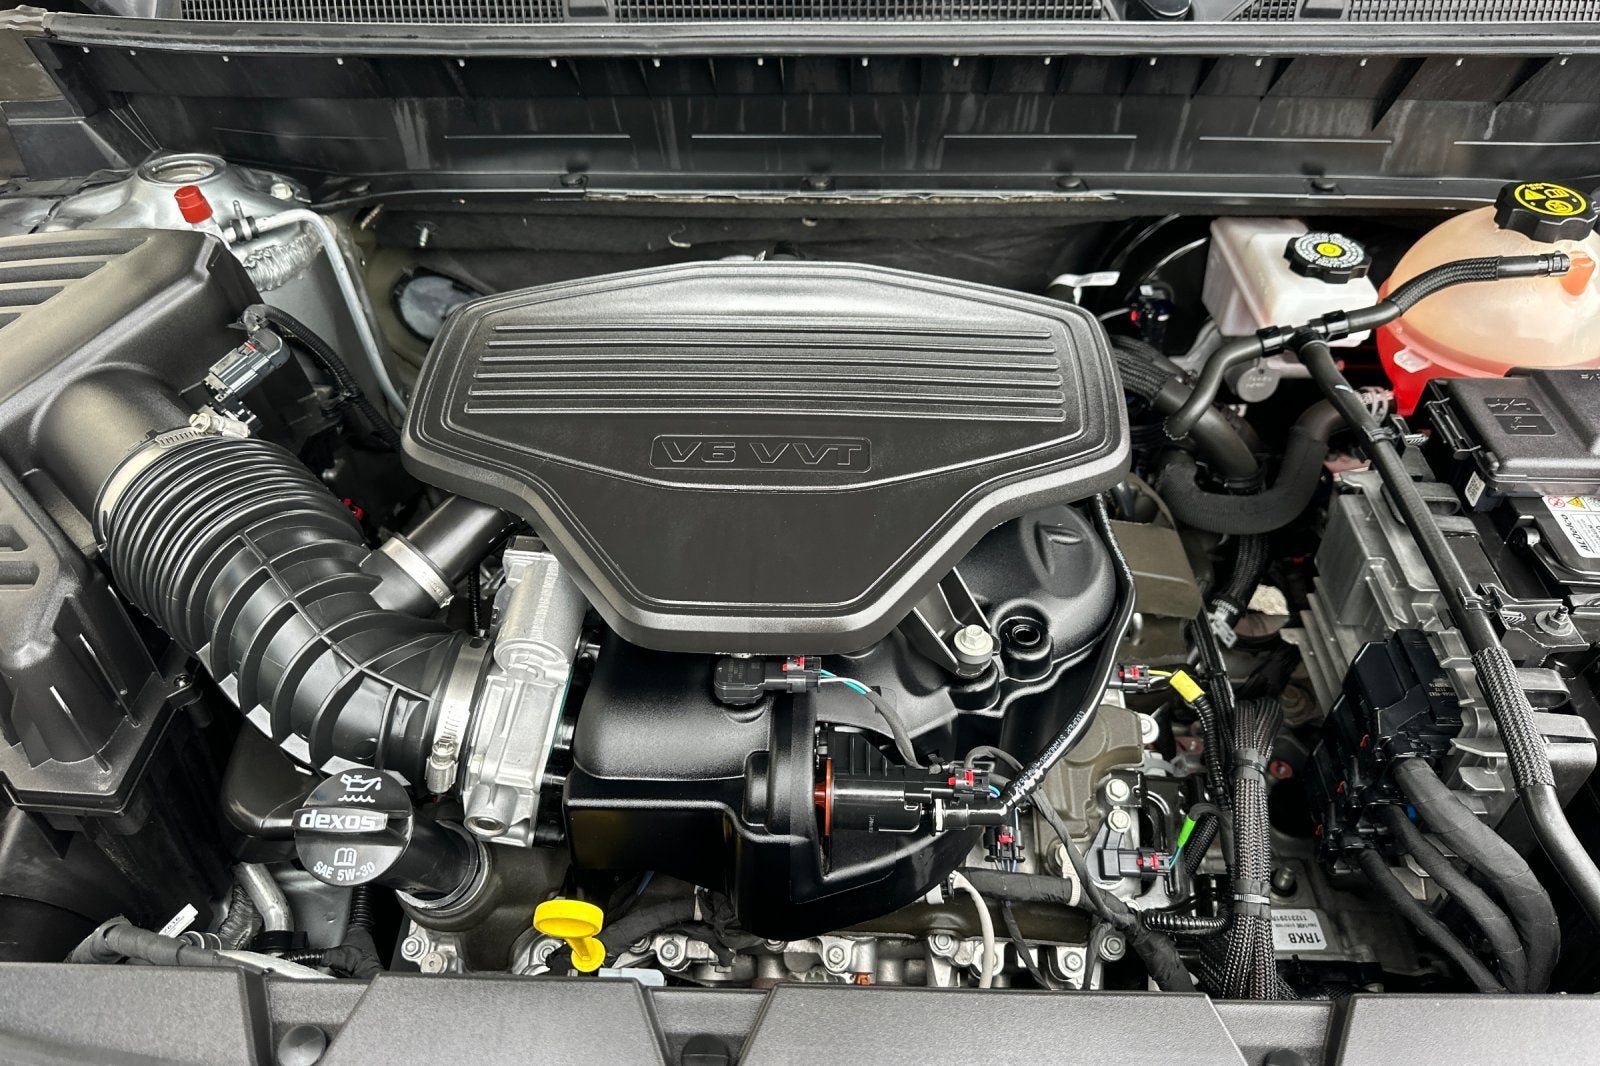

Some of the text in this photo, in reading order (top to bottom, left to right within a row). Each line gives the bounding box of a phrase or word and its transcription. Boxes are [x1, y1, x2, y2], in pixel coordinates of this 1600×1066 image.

[661, 441, 862, 466] V6 VVT
[299, 809, 377, 829] dexos
[313, 861, 376, 881] SAE 5W-30
[1288, 932, 1321, 943] 1RKB
